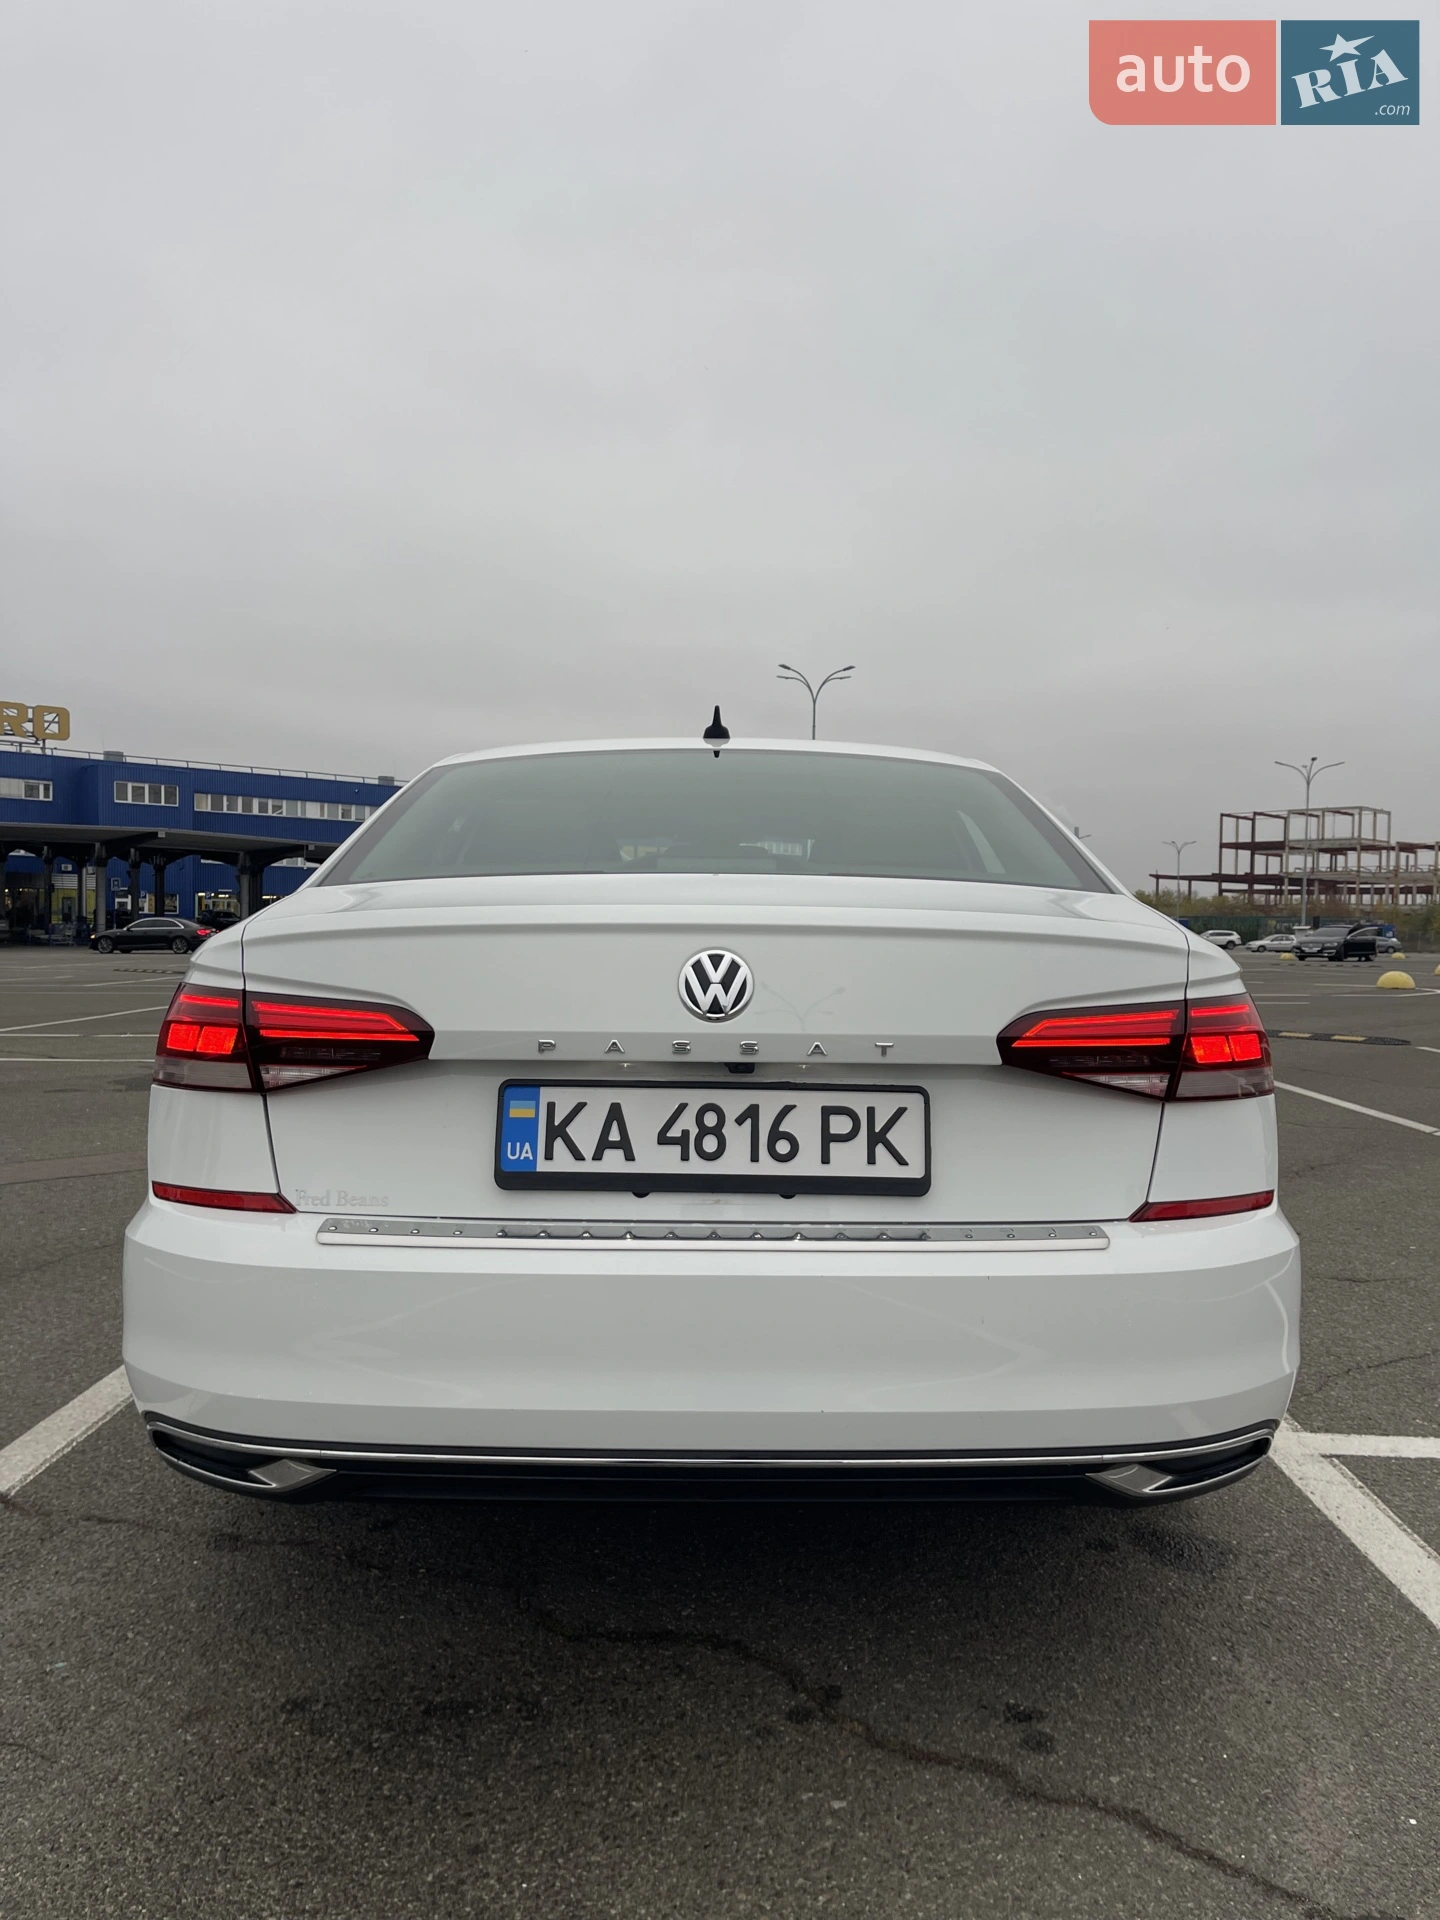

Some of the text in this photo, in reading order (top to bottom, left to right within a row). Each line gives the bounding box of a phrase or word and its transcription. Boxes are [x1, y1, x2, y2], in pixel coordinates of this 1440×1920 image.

[680, 949, 753, 1021] VW
[537, 1038, 894, 1057] PASSAT
[544, 1101, 909, 1166] KA 4816 PK
[506, 1141, 534, 1161] UA
[295, 1189, 389, 1207] Fred Beans
